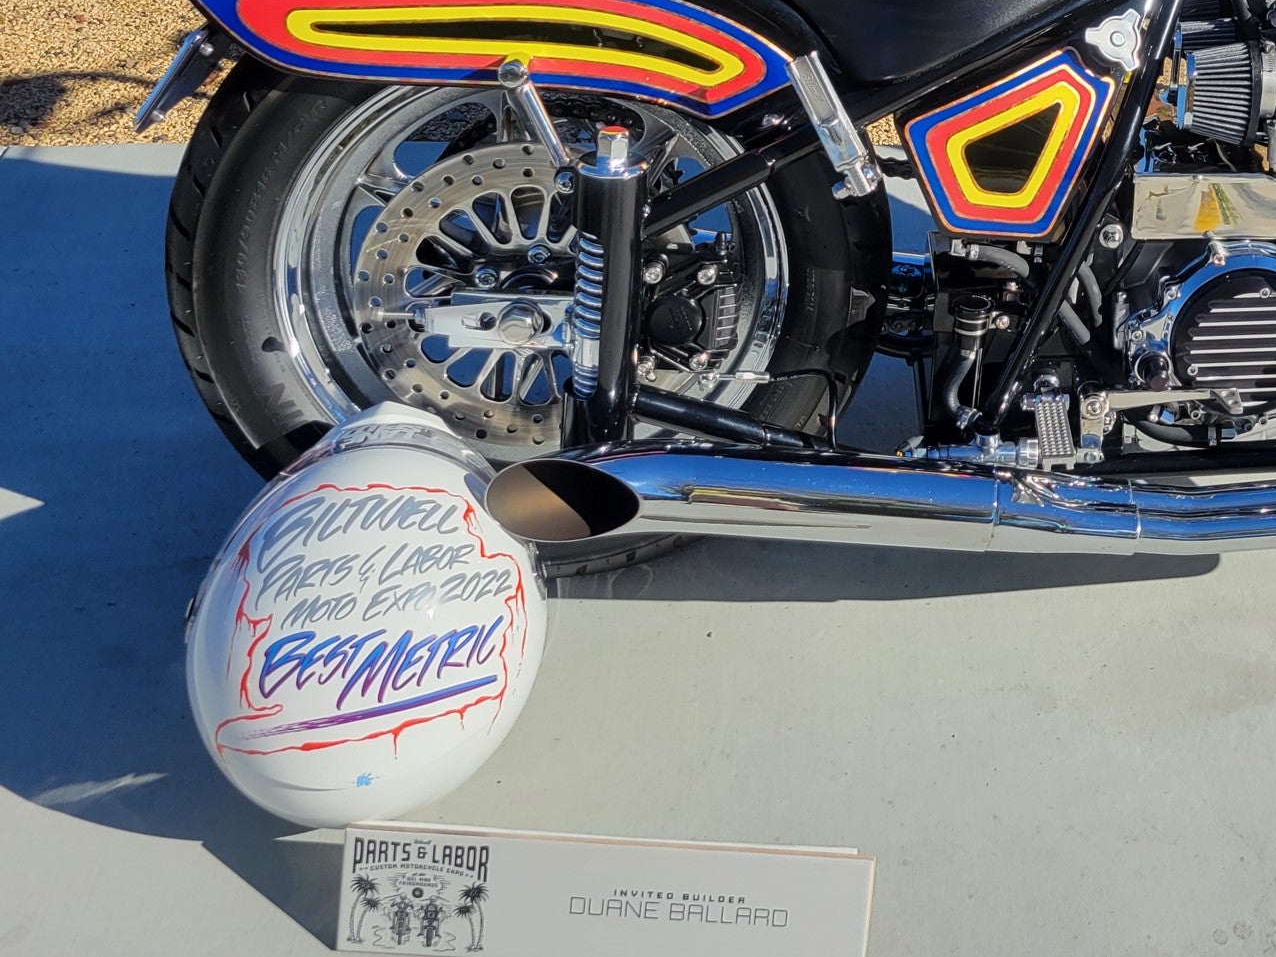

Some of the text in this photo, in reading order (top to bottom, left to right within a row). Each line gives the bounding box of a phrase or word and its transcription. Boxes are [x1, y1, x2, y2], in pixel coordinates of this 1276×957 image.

[257, 494, 460, 574] BILTWELL
[255, 553, 360, 611] PARTS
[378, 543, 475, 585] LABOR
[281, 569, 512, 630] MOTO EXPO 2022
[259, 615, 504, 710] BEST METRIC
[352, 837, 490, 882] PARTS & LABOR
[400, 863, 444, 872] MOTORCYCLE
[569, 896, 789, 927] DUANE BALLARD
[613, 889, 747, 904] INVITED BUILDER
